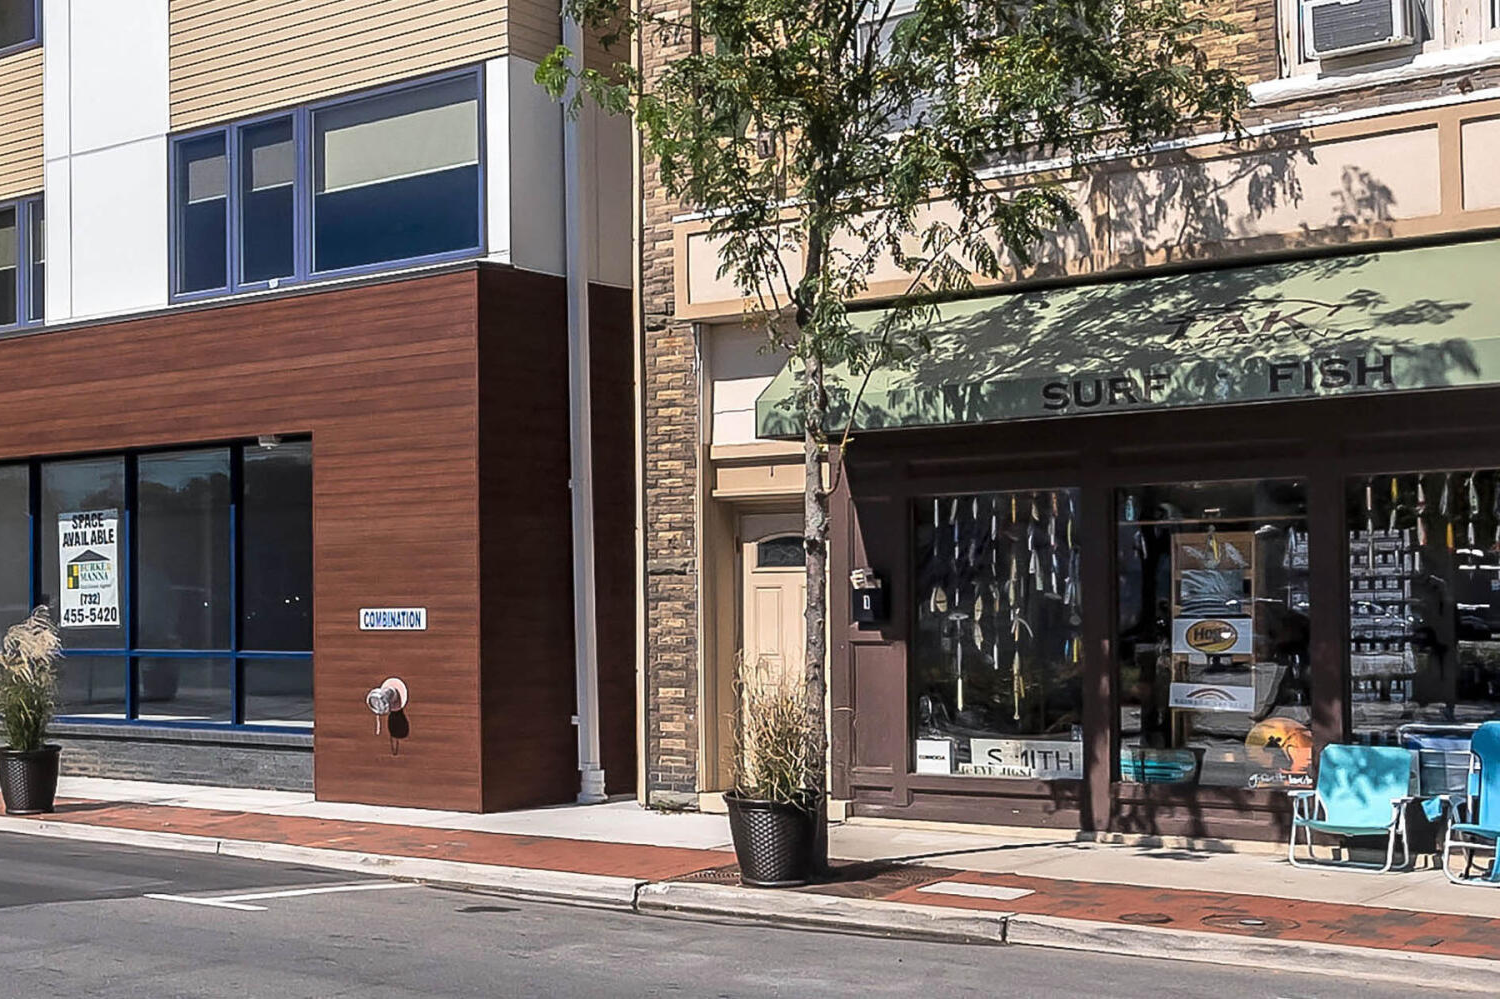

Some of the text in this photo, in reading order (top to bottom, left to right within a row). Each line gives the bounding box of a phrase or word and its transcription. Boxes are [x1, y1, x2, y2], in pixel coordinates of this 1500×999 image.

[1042, 354, 1393, 410] SURF FISH
[71, 512, 104, 529] SPACE
[62, 528, 115, 547] AVAILABLE
[63, 606, 117, 623] 455-5420
[364, 611, 421, 627] COMBINATION
